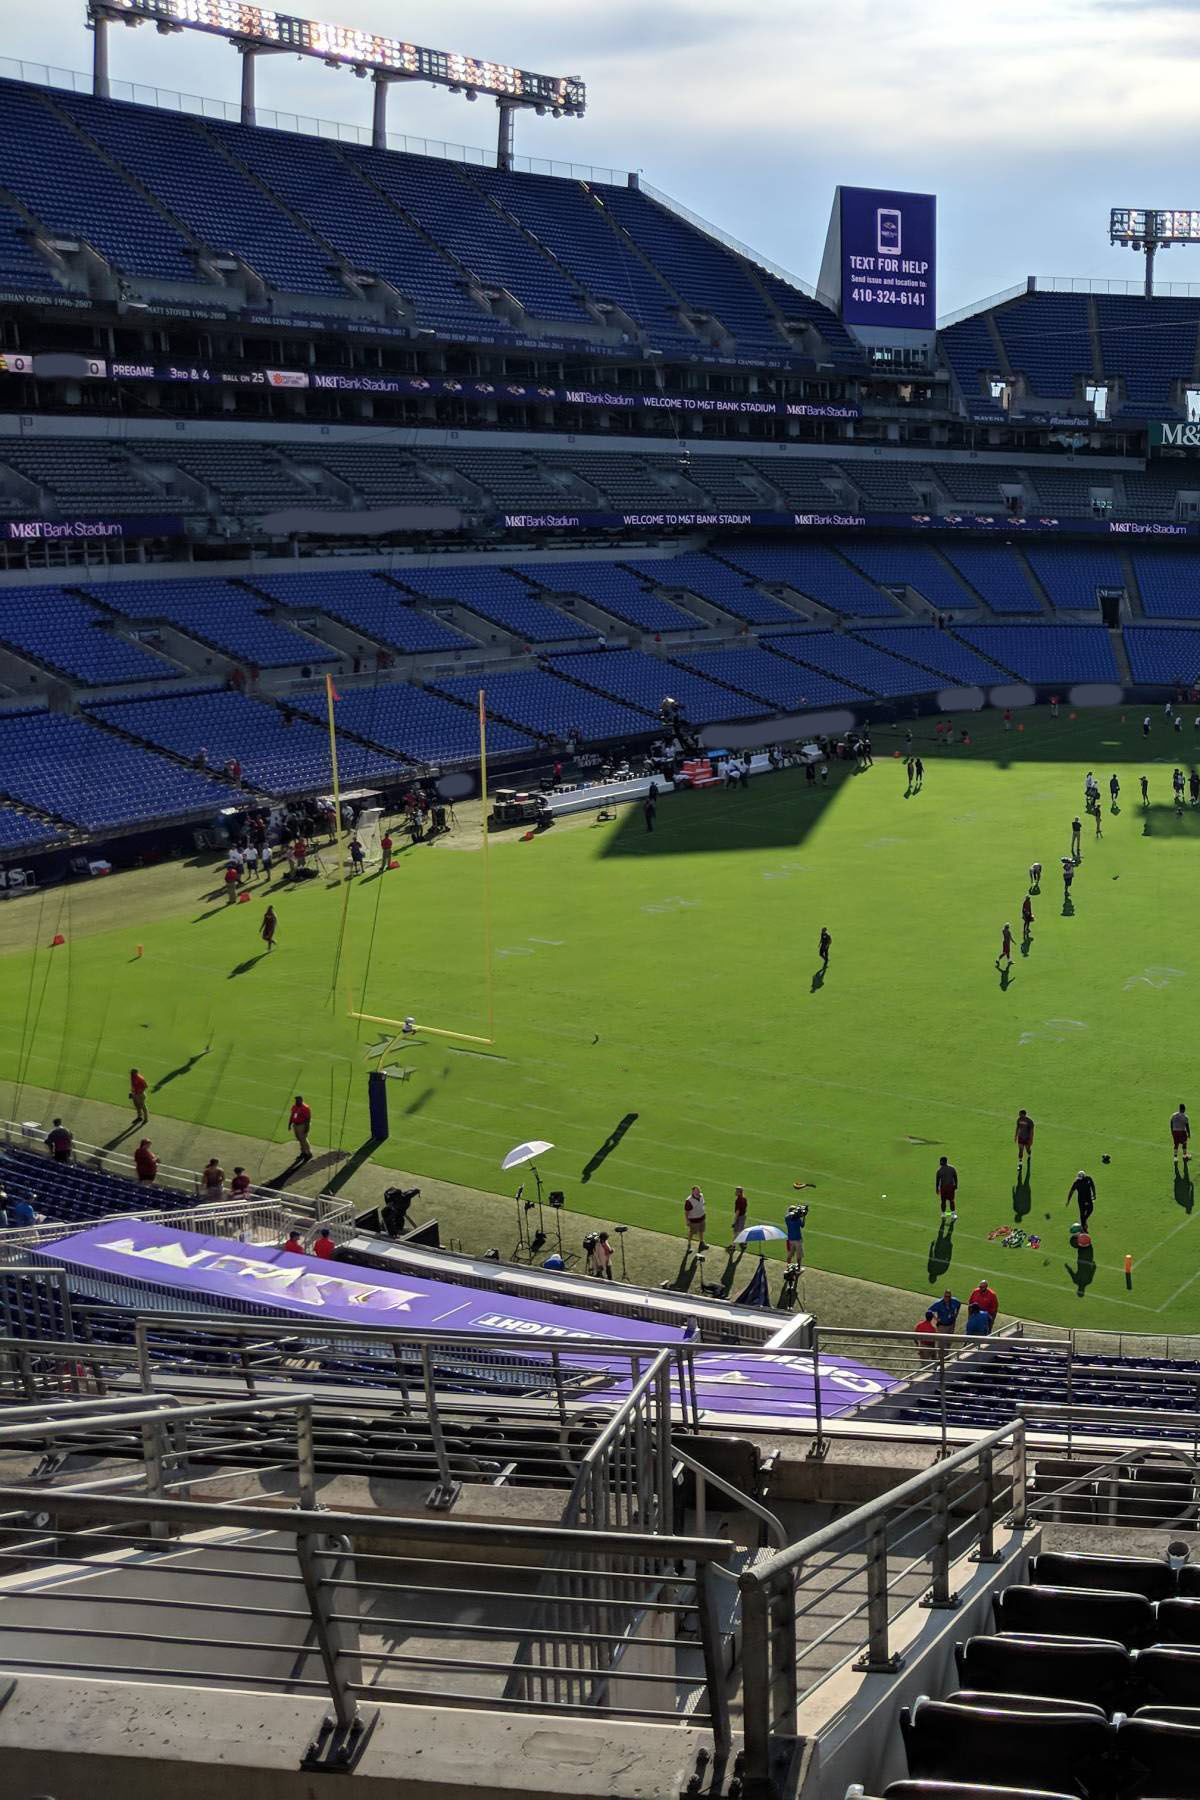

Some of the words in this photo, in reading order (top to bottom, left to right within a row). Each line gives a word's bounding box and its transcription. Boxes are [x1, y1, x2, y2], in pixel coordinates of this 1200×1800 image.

[850, 255, 875, 270] TEXT
[878, 258, 899, 272] FOR
[902, 259, 929, 274] HELP
[851, 274, 866, 283] Send
[867, 276, 882, 284] issue
[883, 277, 894, 285] and
[895, 278, 918, 287] location
[919, 280, 928, 288] to:
[26, 294, 53, 305] OGDEN
[54, 296, 93, 308] 1996-2007
[852, 288, 925, 306] 410-324-6141
[15, 358, 24, 370] 0
[90, 362, 99, 375] 0
[112, 363, 155, 378] PREGAME
[170, 367, 188, 380] 3RD
[191, 368, 200, 380] &
[202, 369, 210, 381] 4
[222, 373, 239, 382] BALL
[251, 372, 265, 383] 25
[314, 375, 340, 389] M&T
[340, 377, 362, 390] Bank
[363, 378, 399, 393] Stadium
[565, 390, 586, 403] M&T
[586, 392, 604, 404] Bank
[604, 393, 635, 406] Stadium
[643, 397, 682, 409] WELCOME
[684, 398, 696, 409] TO
[697, 400, 715, 411] M&T
[717, 400, 739, 412] BANK
[741, 402, 776, 414] STADIUM
[786, 404, 807, 415] M&T
[807, 405, 827, 417] Bank
[827, 406, 858, 418] Stadium
[505, 514, 527, 527] M&T
[527, 515, 547, 527] Bank
[547, 515, 579, 527] Stadium
[624, 515, 664, 525] WELCOME
[666, 515, 677, 525] TO
[678, 515, 695, 525] M&T
[697, 515, 718, 525] BANK
[719, 515, 751, 525] STADIUM
[794, 515, 814, 526] M&T
[814, 515, 833, 526] Bank
[833, 516, 866, 527] Stadium
[10, 522, 43, 538] M&T
[43, 521, 74, 538] Bank
[74, 521, 123, 537] Stadium
[1110, 522, 1132, 533] M&T
[1132, 523, 1153, 534] Bank
[1153, 523, 1187, 535] Stadium
